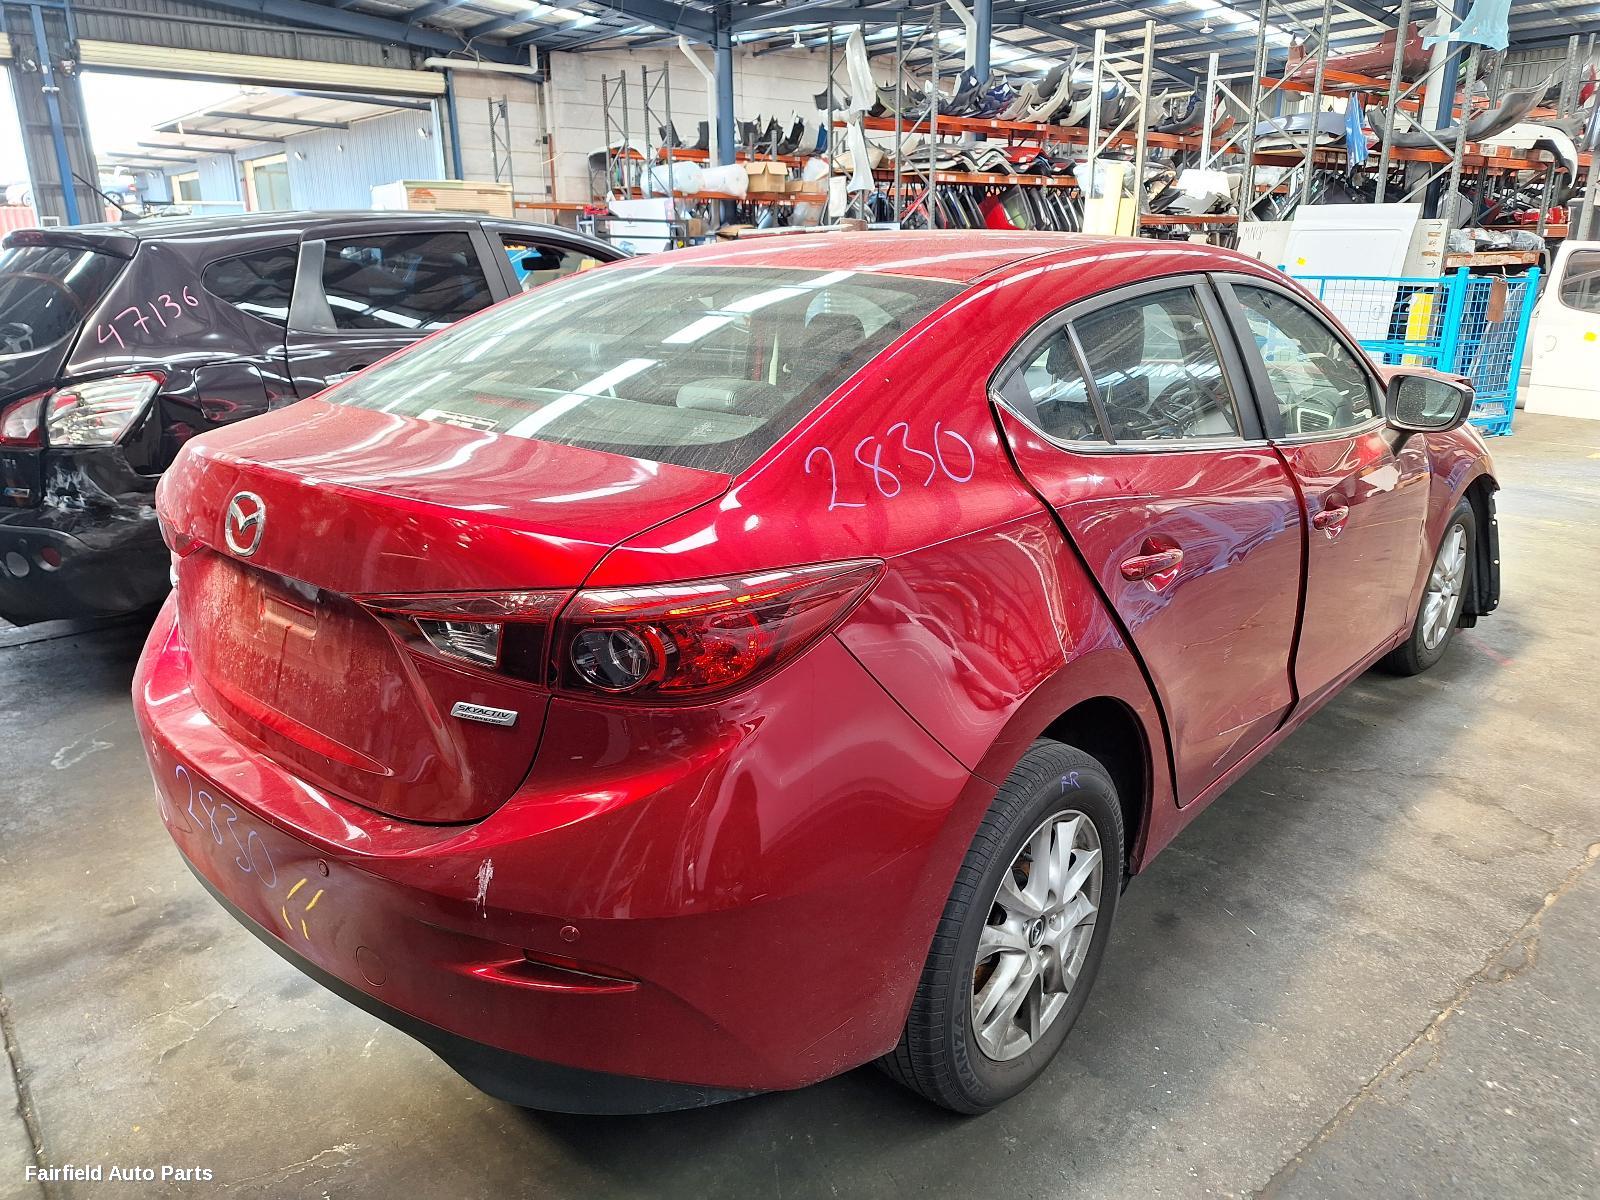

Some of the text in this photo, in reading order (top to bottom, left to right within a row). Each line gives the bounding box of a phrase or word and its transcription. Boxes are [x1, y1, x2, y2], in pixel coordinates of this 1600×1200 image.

[97, 286, 199, 349] 47136
[804, 421, 976, 511] 2830
[457, 705, 511, 718] SKYACTIV
[174, 764, 278, 889] 2830
